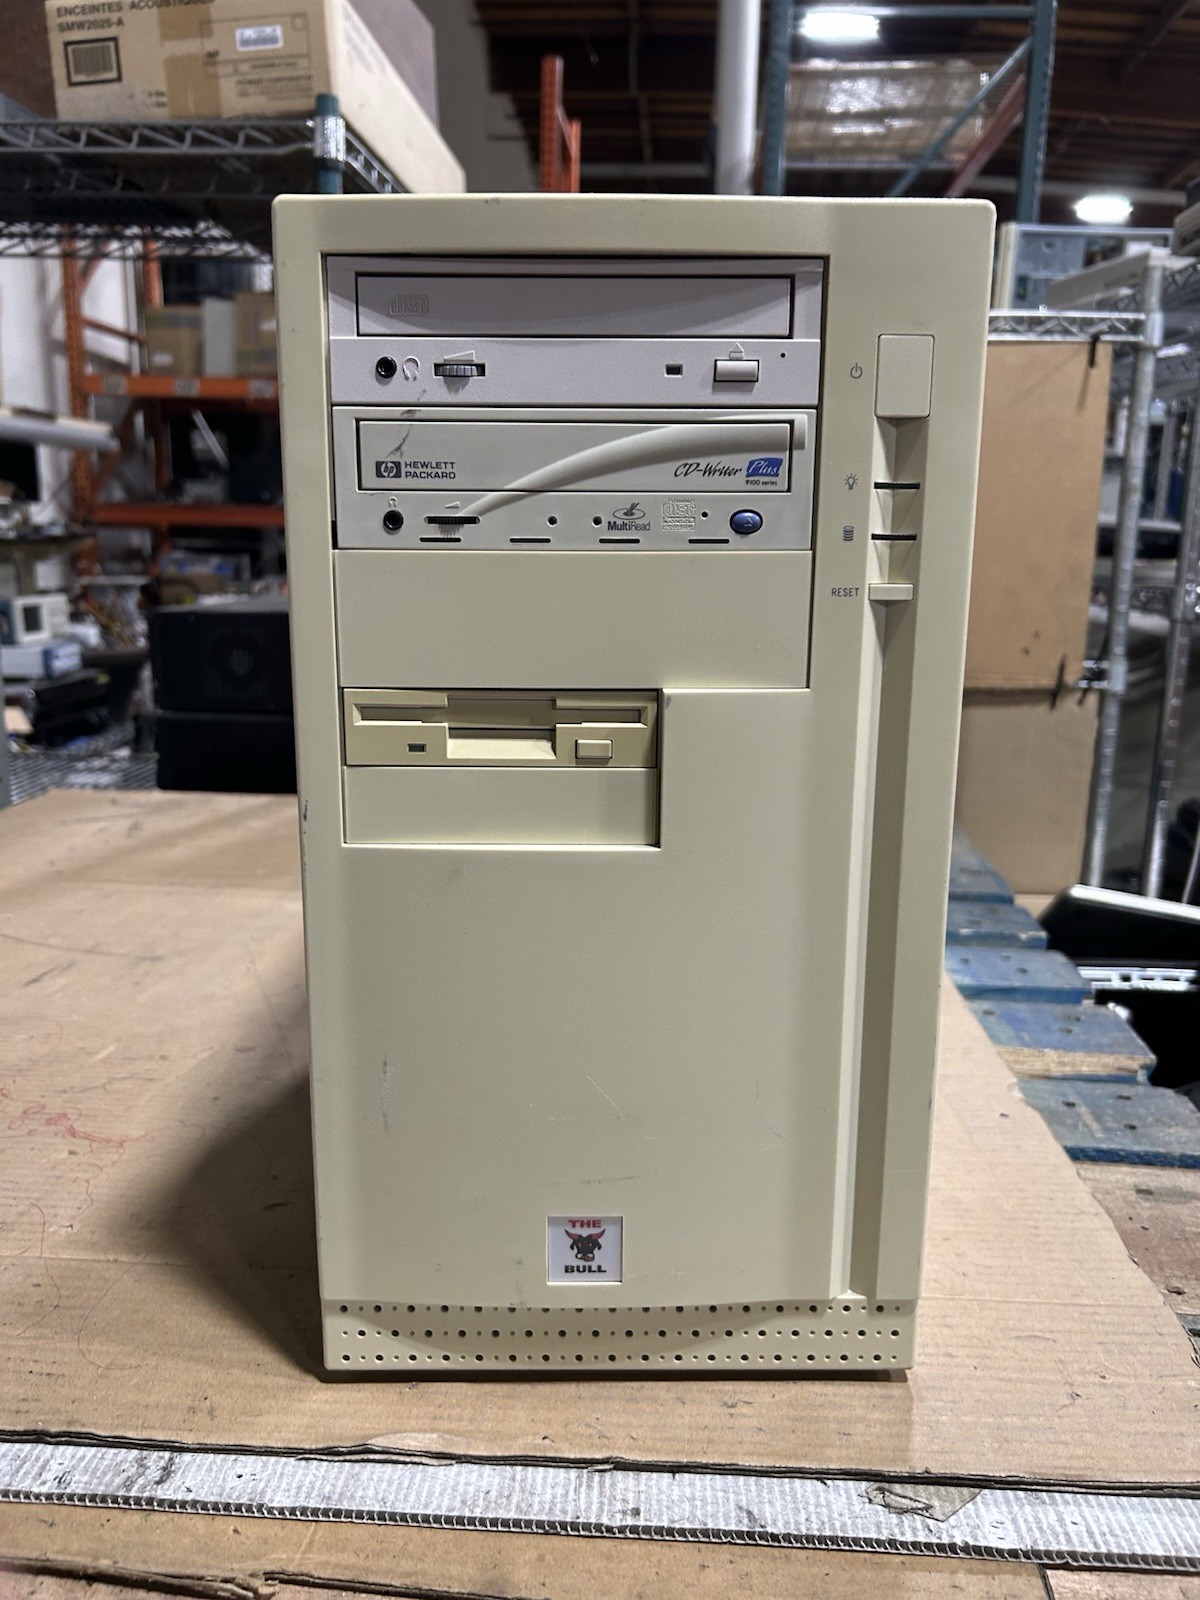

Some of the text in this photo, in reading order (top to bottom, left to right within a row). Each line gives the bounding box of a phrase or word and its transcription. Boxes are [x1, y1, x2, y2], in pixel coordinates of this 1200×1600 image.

[56, 2, 123, 17] ENCEINTES
[380, 461, 398, 478] hp
[404, 461, 455, 469] HEWLETT
[674, 460, 778, 477] CD-Writer Plus
[405, 471, 456, 479] PACKARD
[607, 521, 651, 531] MultiRead
[831, 587, 860, 597] RESET
[568, 1219, 602, 1228] THE
[564, 1265, 607, 1273] BULL
